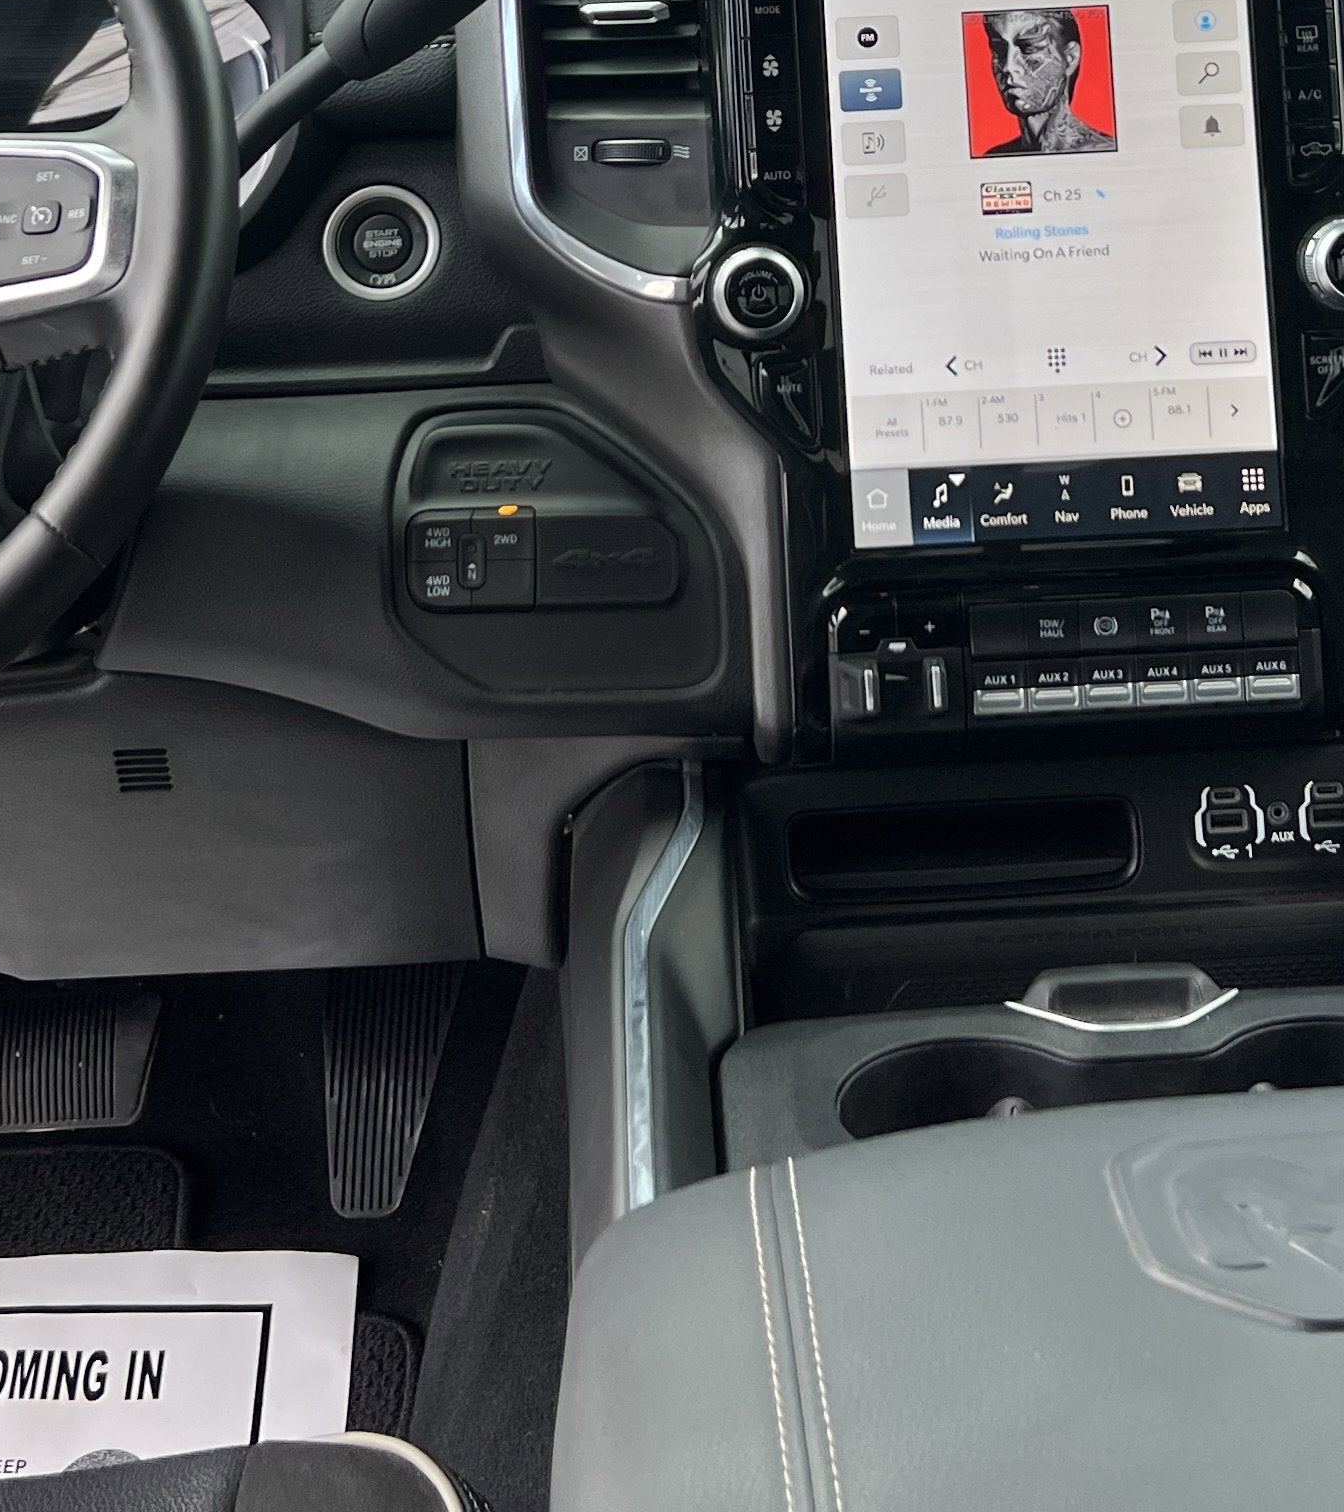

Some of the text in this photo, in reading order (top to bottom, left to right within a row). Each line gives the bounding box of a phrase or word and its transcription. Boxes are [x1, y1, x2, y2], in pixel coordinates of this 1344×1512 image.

[754, 5, 781, 15] MODE
[860, 33, 876, 43] FM
[1298, 88, 1322, 100] A/C
[763, 171, 792, 181] AUTO
[1042, 189, 1082, 202] Ch 25
[67, 208, 85, 219] RES
[365, 228, 399, 238] START
[995, 224, 1089, 242] Rolling Stones
[369, 249, 398, 258] STOP
[979, 244, 1110, 263] Waiting On A Friend
[1129, 351, 1149, 364] CH
[869, 363, 914, 376] Related
[963, 359, 983, 372] CH
[450, 458, 552, 478] HEAVY
[1110, 507, 1149, 521] Phone
[1170, 503, 1215, 518] Vehicle
[1239, 501, 1271, 517] Apps
[923, 516, 961, 530] Media
[981, 512, 1029, 527] Comfort
[1055, 511, 1080, 524] Nav
[861, 520, 897, 533] Home
[426, 527, 450, 538] 4WD
[424, 538, 452, 548] HIGH
[494, 534, 518, 545] 2WD
[426, 575, 450, 586] 4WD
[467, 570, 477, 581] N
[427, 586, 451, 597] LOW
[1147, 667, 1171, 677] AUX
[1201, 664, 1224, 675] AUX
[1256, 661, 1278, 672] AUX
[984, 675, 1007, 686] AUX
[1038, 673, 1061, 684] AUX
[1092, 670, 1115, 681] AUX
[1270, 831, 1295, 843] AUX
[1245, 844, 1253, 859] 1
[126, 1348, 167, 1403] IN
